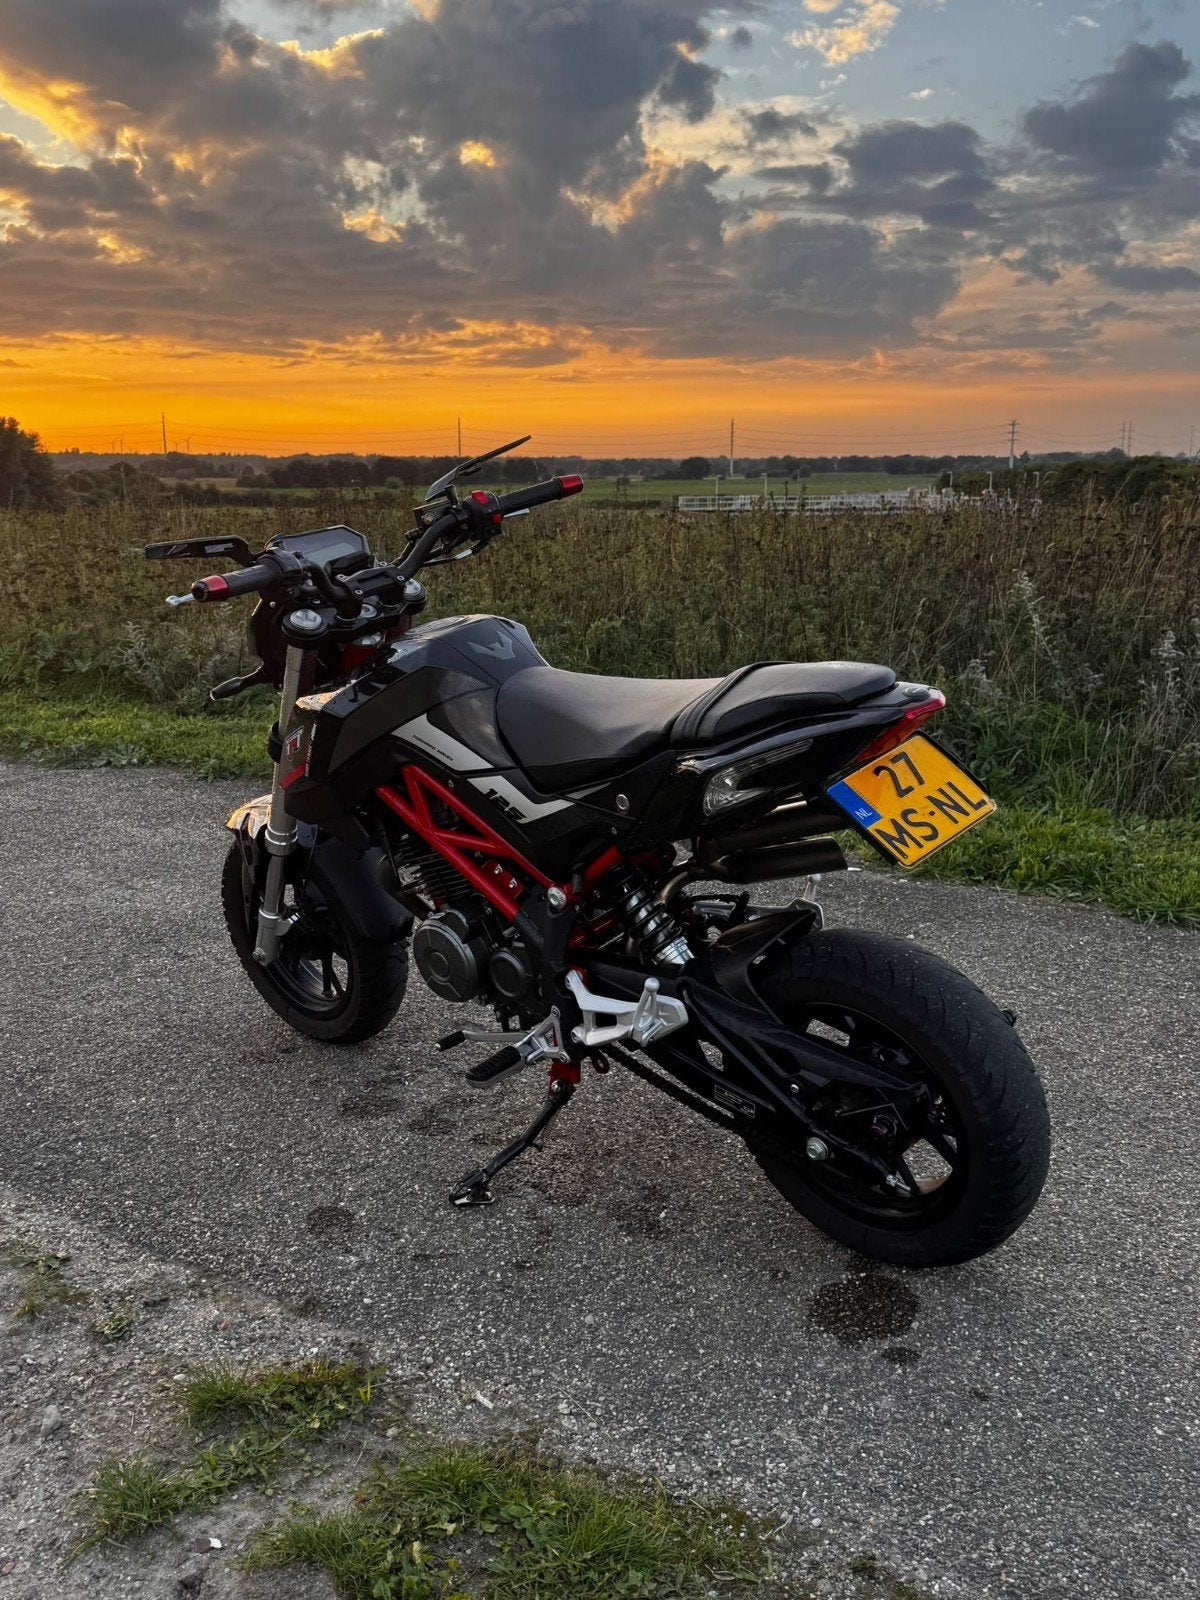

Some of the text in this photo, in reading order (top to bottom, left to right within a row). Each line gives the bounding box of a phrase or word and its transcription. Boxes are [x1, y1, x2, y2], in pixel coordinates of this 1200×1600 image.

[873, 751, 925, 798] 27
[484, 788, 528, 821] 125
[854, 807, 873, 820] NL
[874, 781, 988, 859] MS-NL
